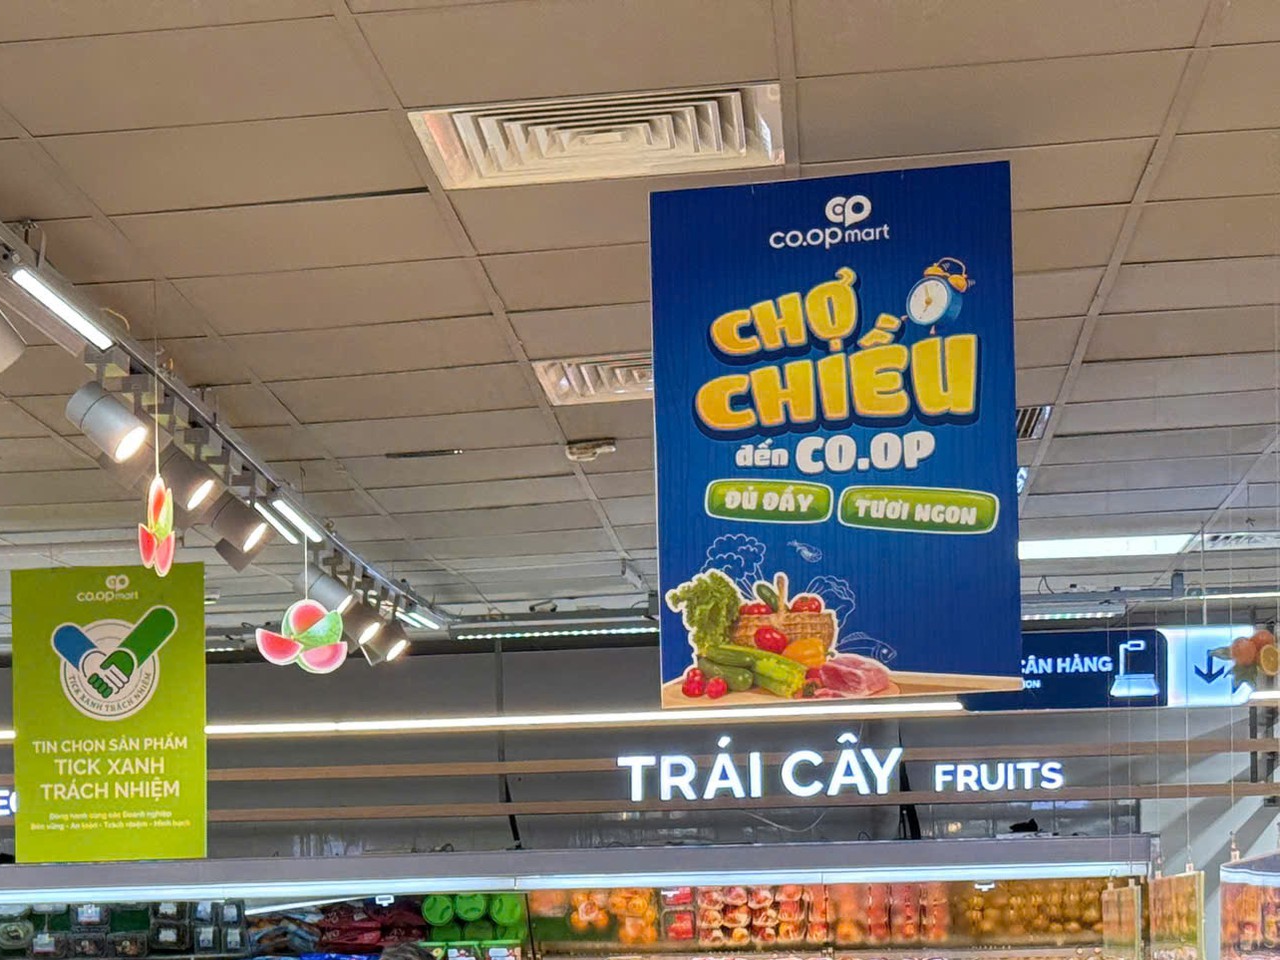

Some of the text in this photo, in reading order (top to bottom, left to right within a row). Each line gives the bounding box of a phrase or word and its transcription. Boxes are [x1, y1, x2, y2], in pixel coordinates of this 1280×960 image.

[709, 266, 858, 355] CHỢ
[695, 312, 980, 431] CHIỀU
[734, 431, 936, 474] đến CO.OP
[724, 485, 815, 513] ĐỦ ĐẦY
[854, 496, 978, 526] TƯƠI NGON
[1056, 653, 1114, 673] HÀNG
[32, 731, 188, 756] TIN CHỌN SẢN PHẨM
[54, 756, 165, 776] TICK XANH
[616, 731, 1066, 803] TRÁI CÂY FRUITS
[39, 776, 181, 802] TRÁCH NHIỆM
